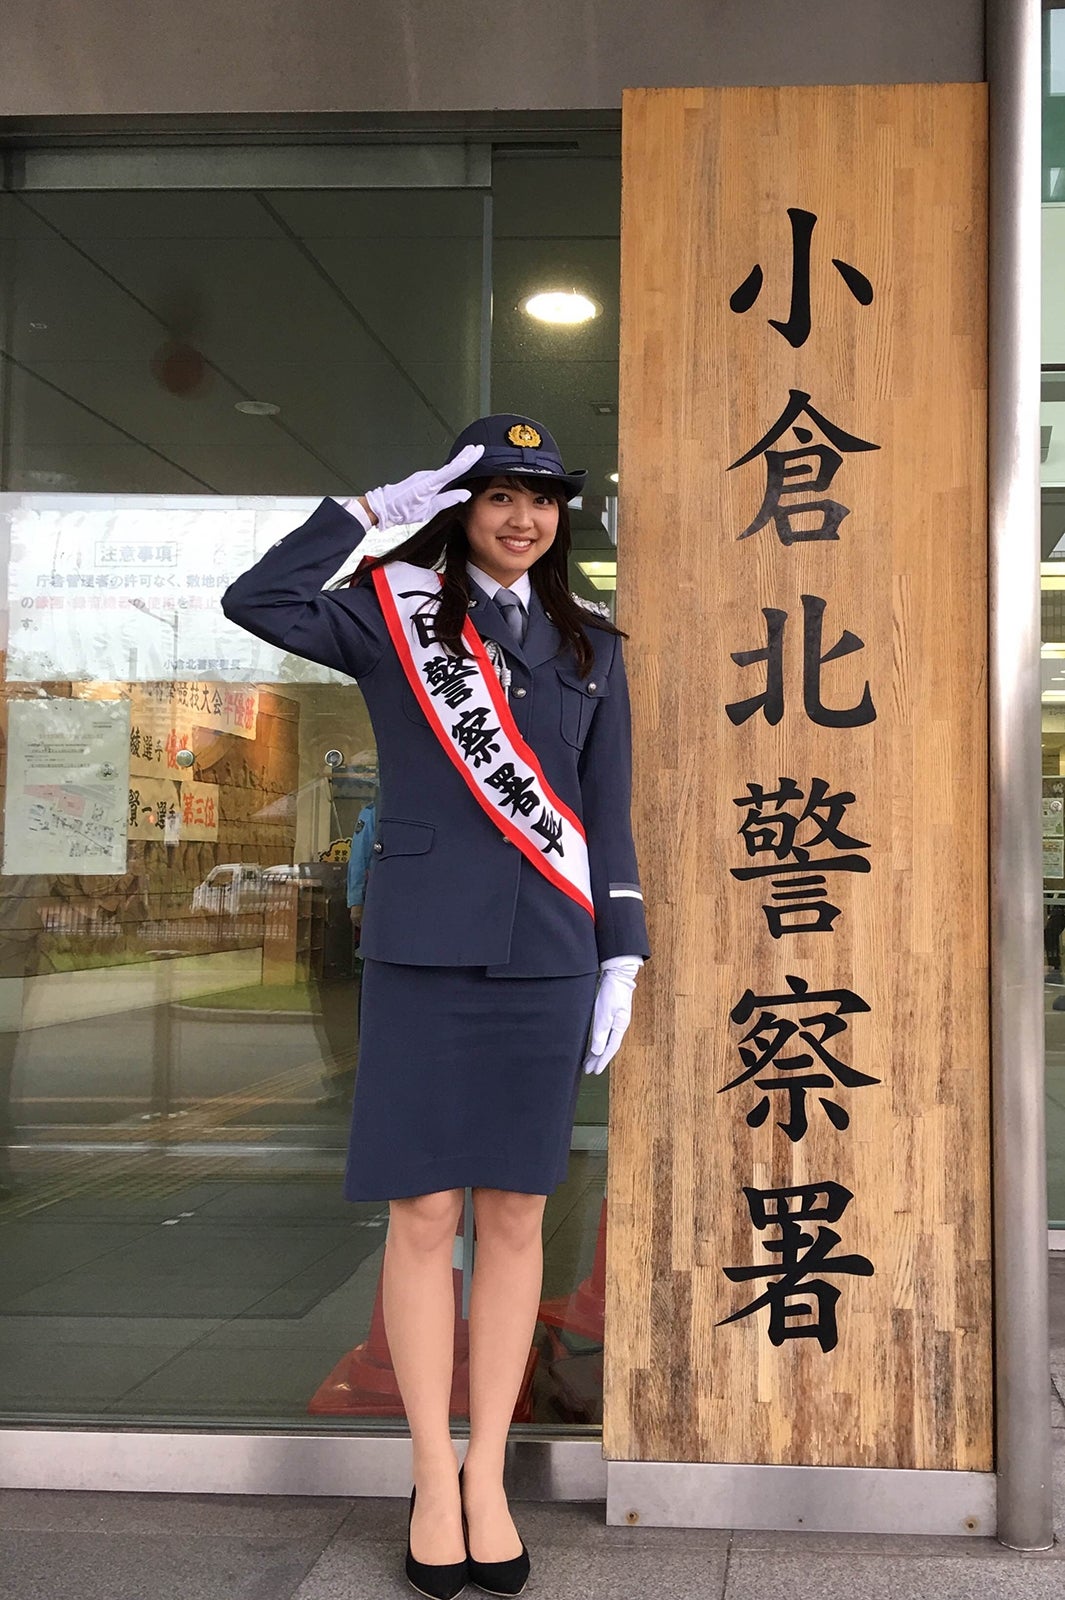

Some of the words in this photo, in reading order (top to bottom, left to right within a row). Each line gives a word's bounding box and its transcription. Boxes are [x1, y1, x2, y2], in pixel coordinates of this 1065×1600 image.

[101, 545, 173, 562] 注意事項
[36, 573, 237, 590] 庁舎管理者の許可なく、敷地内
[715, 207, 882, 1355] 小倉北警察署
